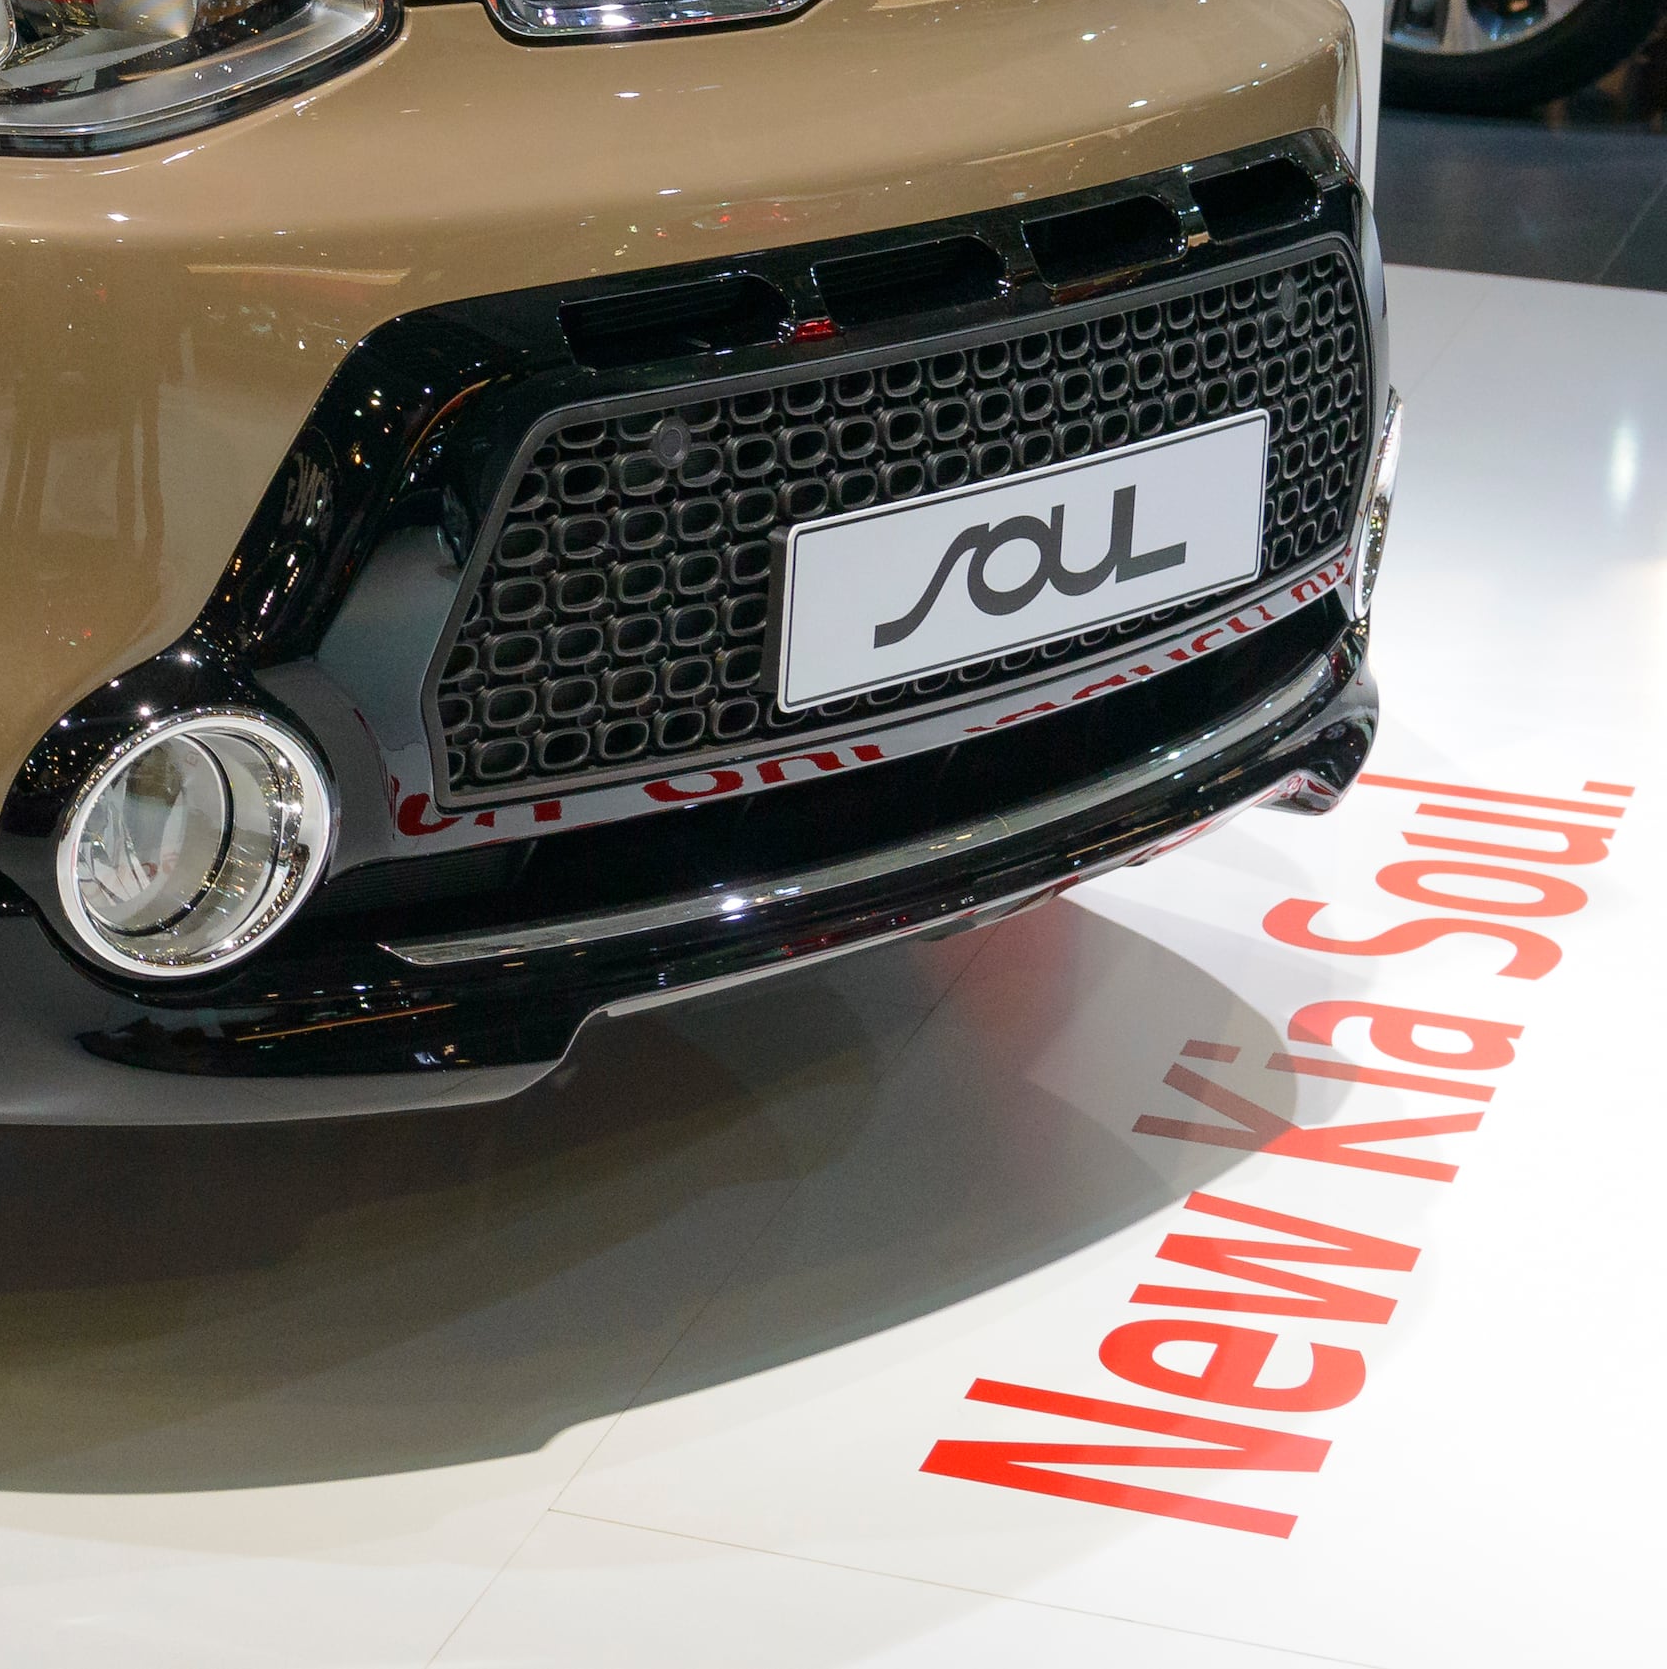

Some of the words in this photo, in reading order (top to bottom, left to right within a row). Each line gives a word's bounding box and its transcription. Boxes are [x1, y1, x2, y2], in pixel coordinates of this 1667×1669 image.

[873, 485, 1187, 649] SOUL
[1263, 773, 1636, 980] Soul.
[1132, 1001, 1525, 1183] Kia
[919, 1191, 1421, 1540] New
